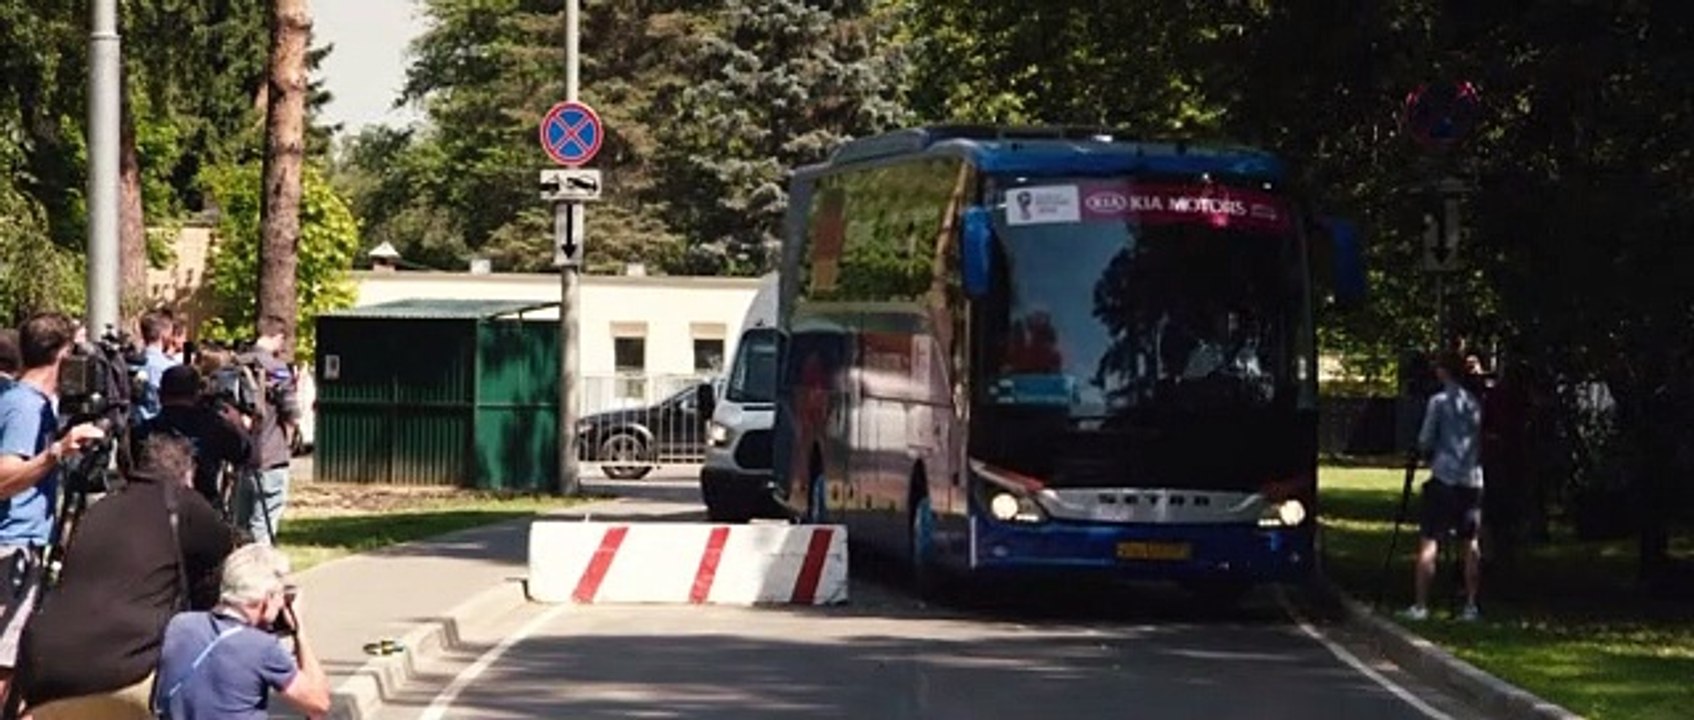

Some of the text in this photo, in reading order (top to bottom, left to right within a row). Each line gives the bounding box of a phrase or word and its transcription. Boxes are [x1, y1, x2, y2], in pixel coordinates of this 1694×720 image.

[1090, 194, 1124, 211] KIA
[1130, 195, 1163, 211] KIA
[1168, 197, 1247, 215] MOTORS
